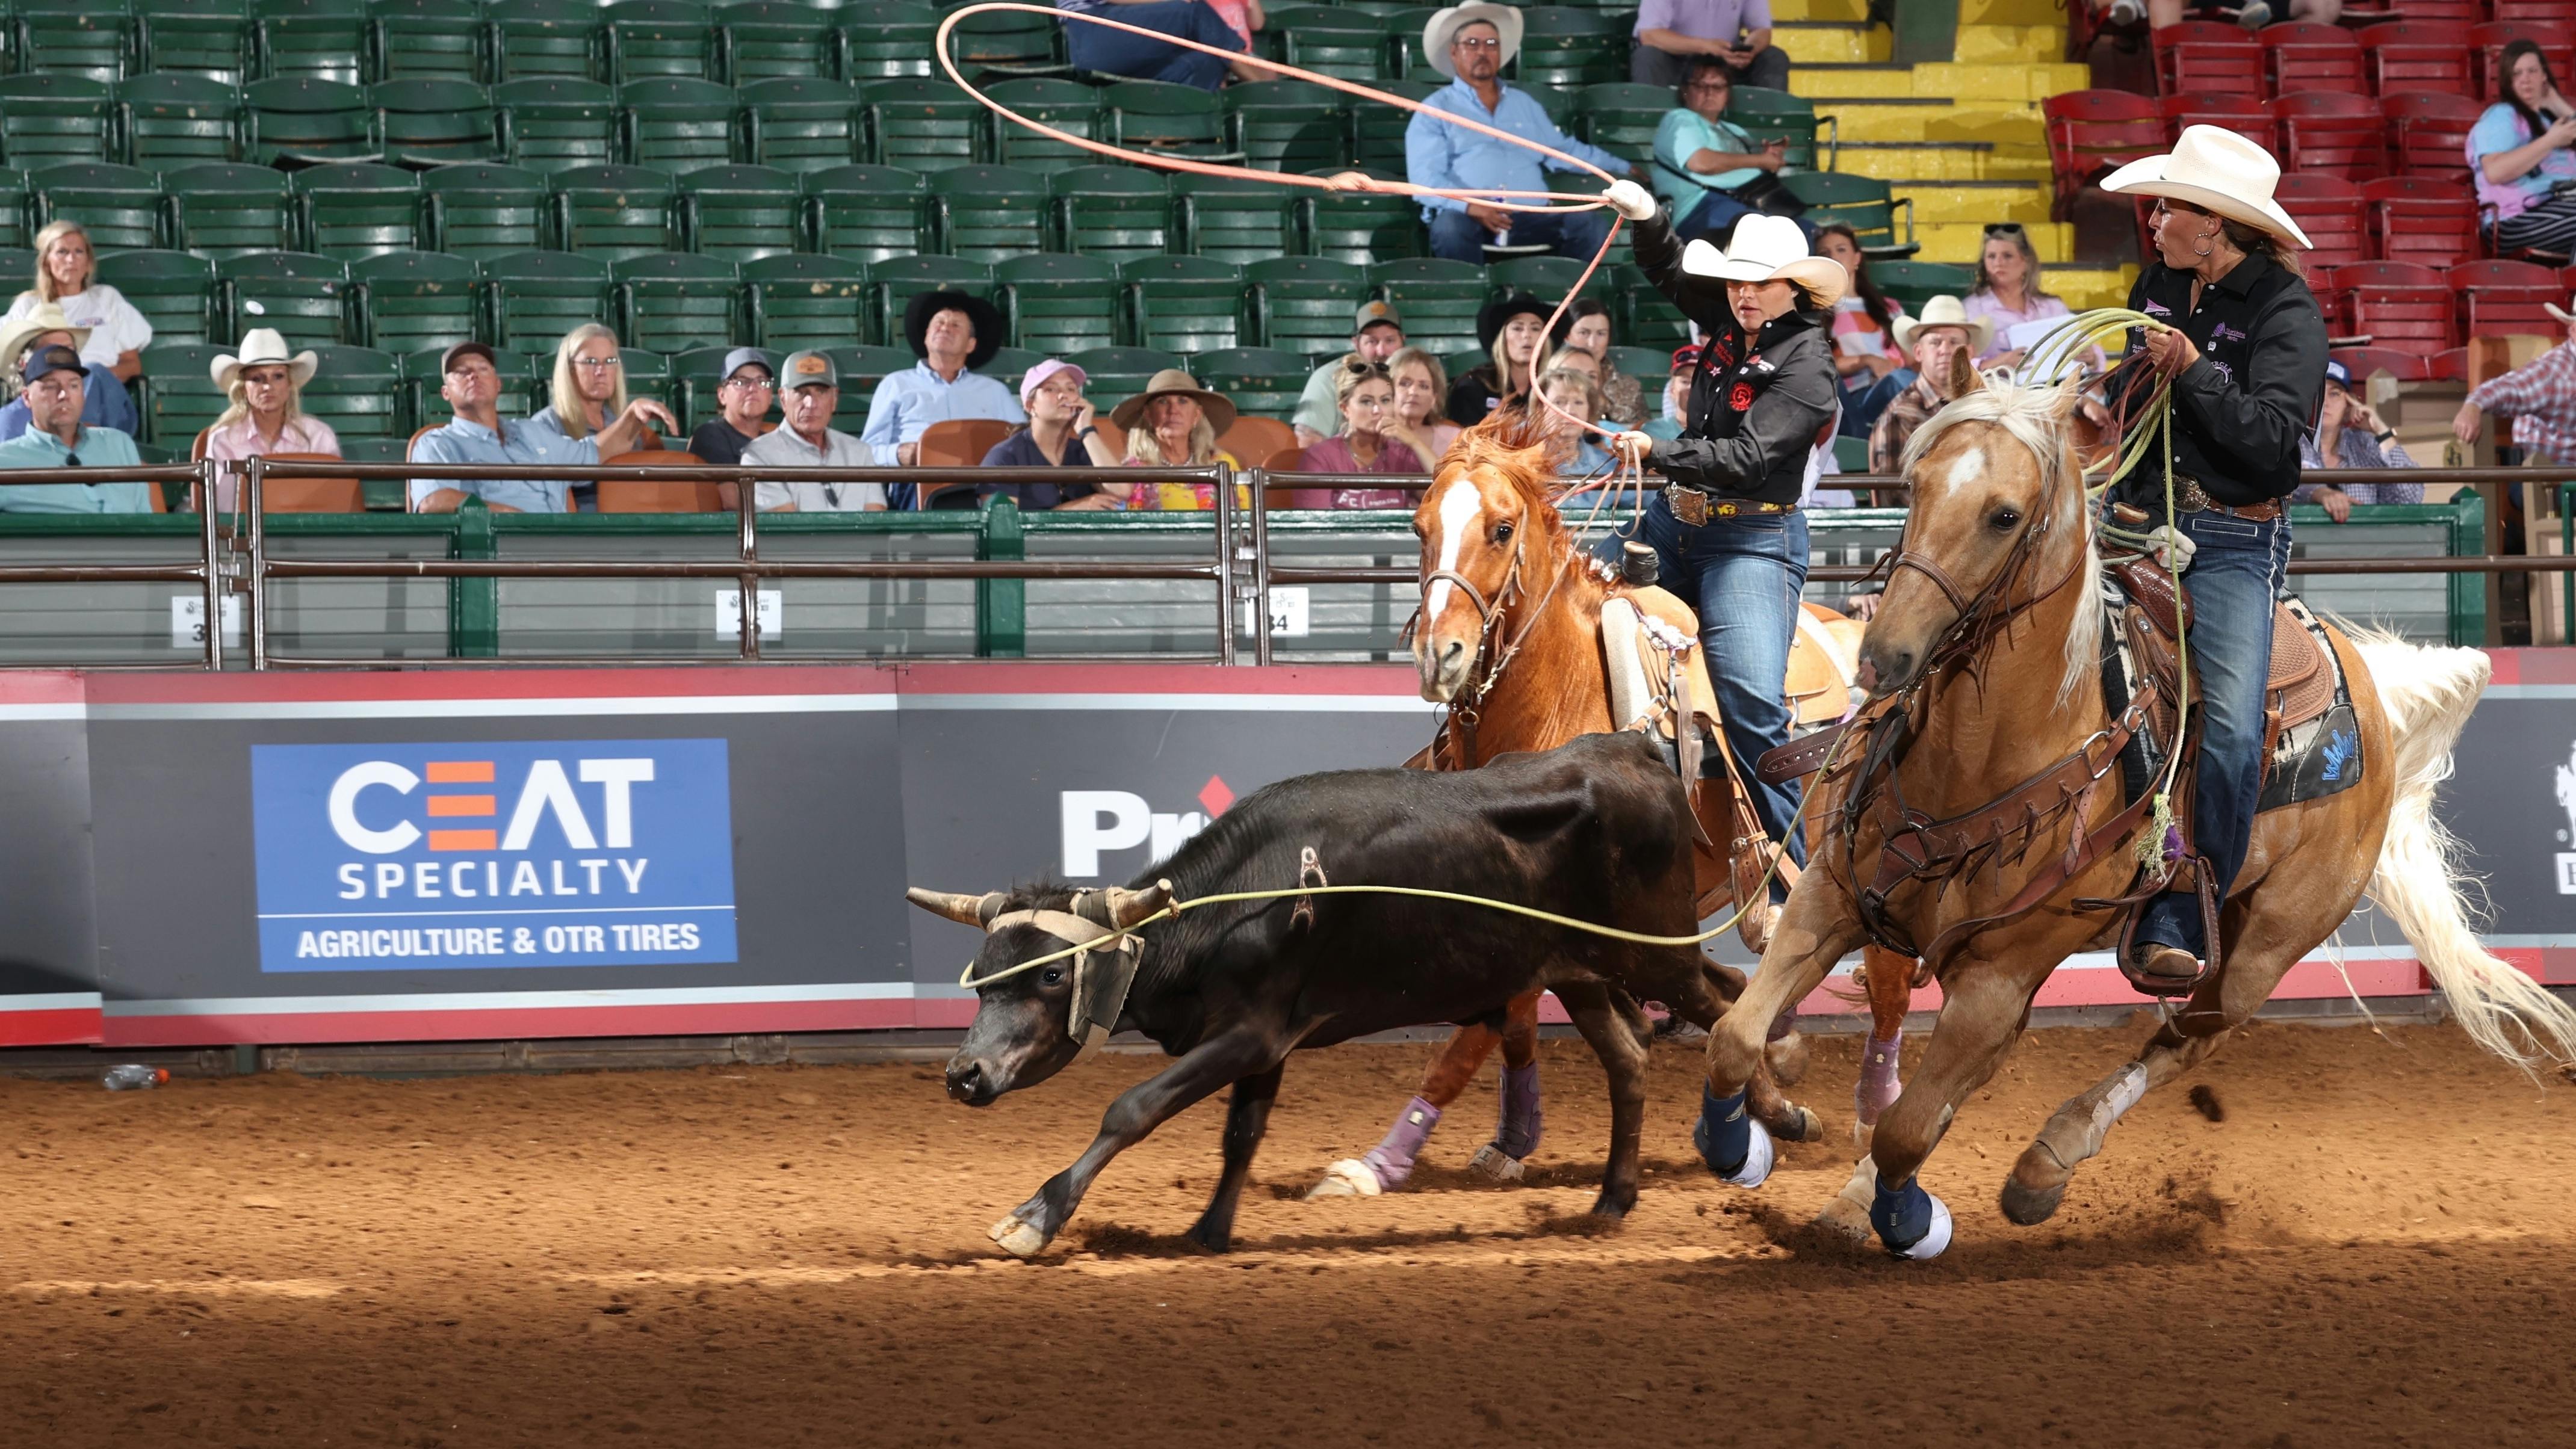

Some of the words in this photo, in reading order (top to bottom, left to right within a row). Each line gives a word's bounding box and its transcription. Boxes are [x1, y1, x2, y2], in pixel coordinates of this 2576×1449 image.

[2211, 361, 2233, 374] IRCLE
[328, 758, 654, 854] CEAT
[338, 858, 648, 900] SPECIALTY
[297, 927, 505, 958] AGRICULTURE
[512, 927, 537, 954] &
[544, 925, 605, 954] OTR
[611, 922, 701, 951] TIRES
